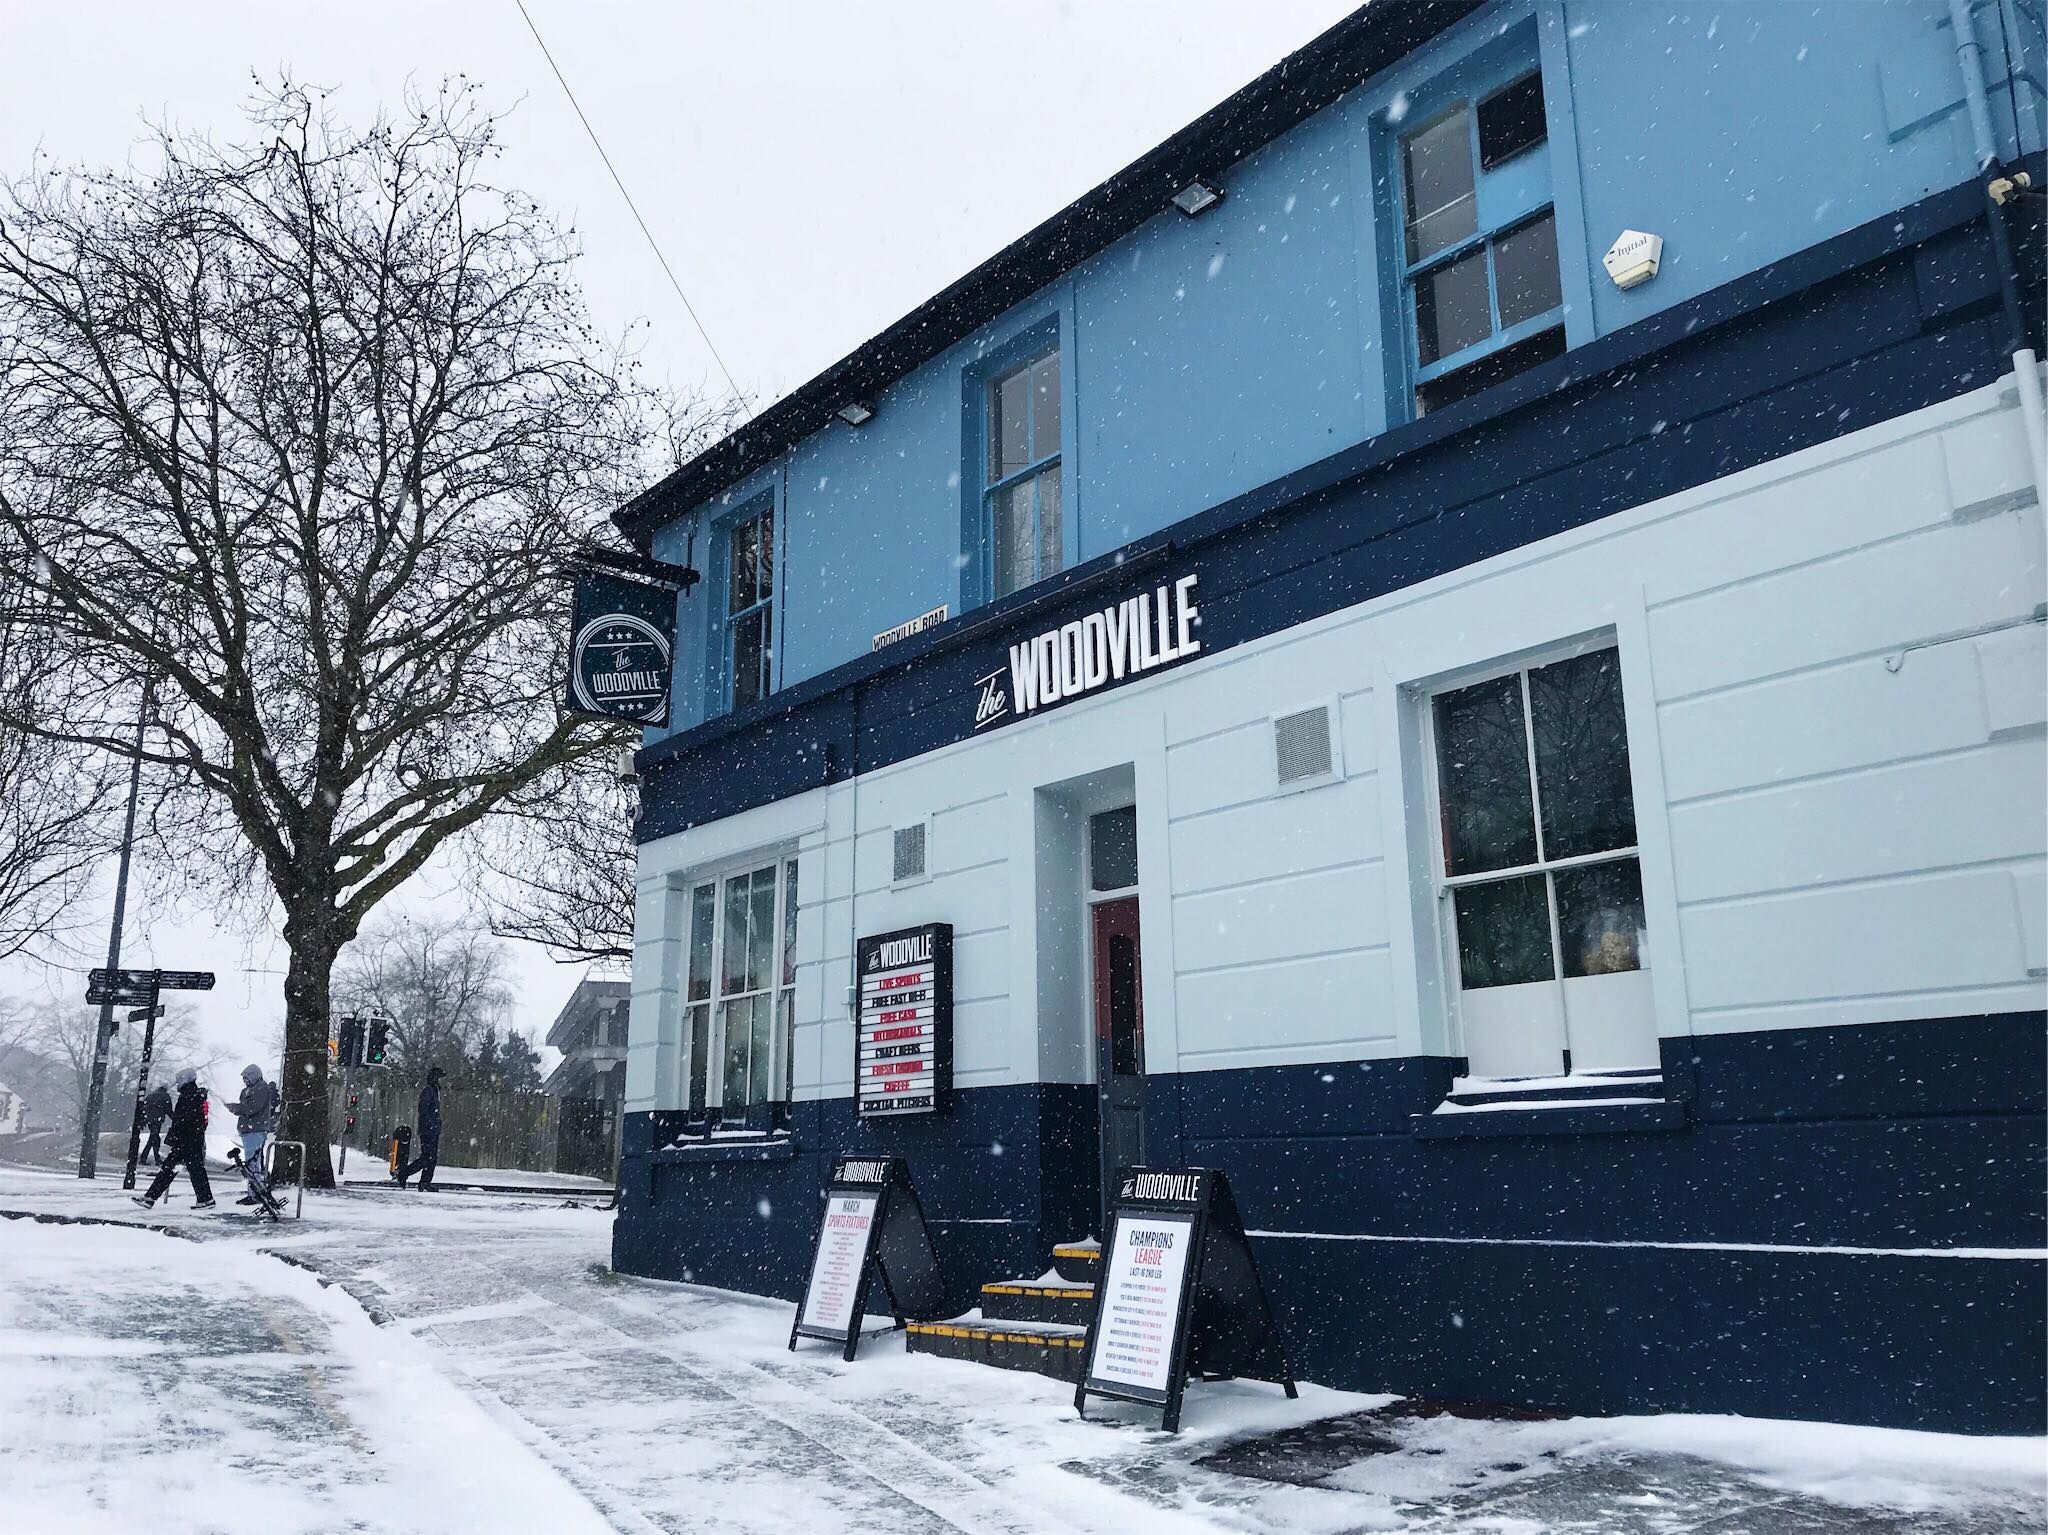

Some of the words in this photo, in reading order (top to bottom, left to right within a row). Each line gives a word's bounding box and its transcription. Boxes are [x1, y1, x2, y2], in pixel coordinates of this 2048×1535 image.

[1617, 236, 1647, 256] Initial
[873, 621, 918, 651] WOODVILLE
[922, 608, 945, 632] ROAD
[613, 649, 632, 670] the
[975, 670, 1007, 725] the
[1009, 574, 1201, 714] WOODVILLE
[592, 671, 661, 693] WOODVILLE
[880, 934, 932, 968] WOODVILLE
[843, 1162, 884, 1183] WOODVILLE
[1121, 1178, 1134, 1198] the
[1134, 1173, 1200, 1201] WOODVILLE
[842, 1200, 860, 1213] MARCH
[827, 1214, 847, 1229] SPORTS
[846, 1216, 870, 1230] FIXTURES
[1129, 1230, 1174, 1249] CHAMPIONS
[1134, 1248, 1163, 1266] LEAGUE
[1129, 1267, 1140, 1277] LAST
